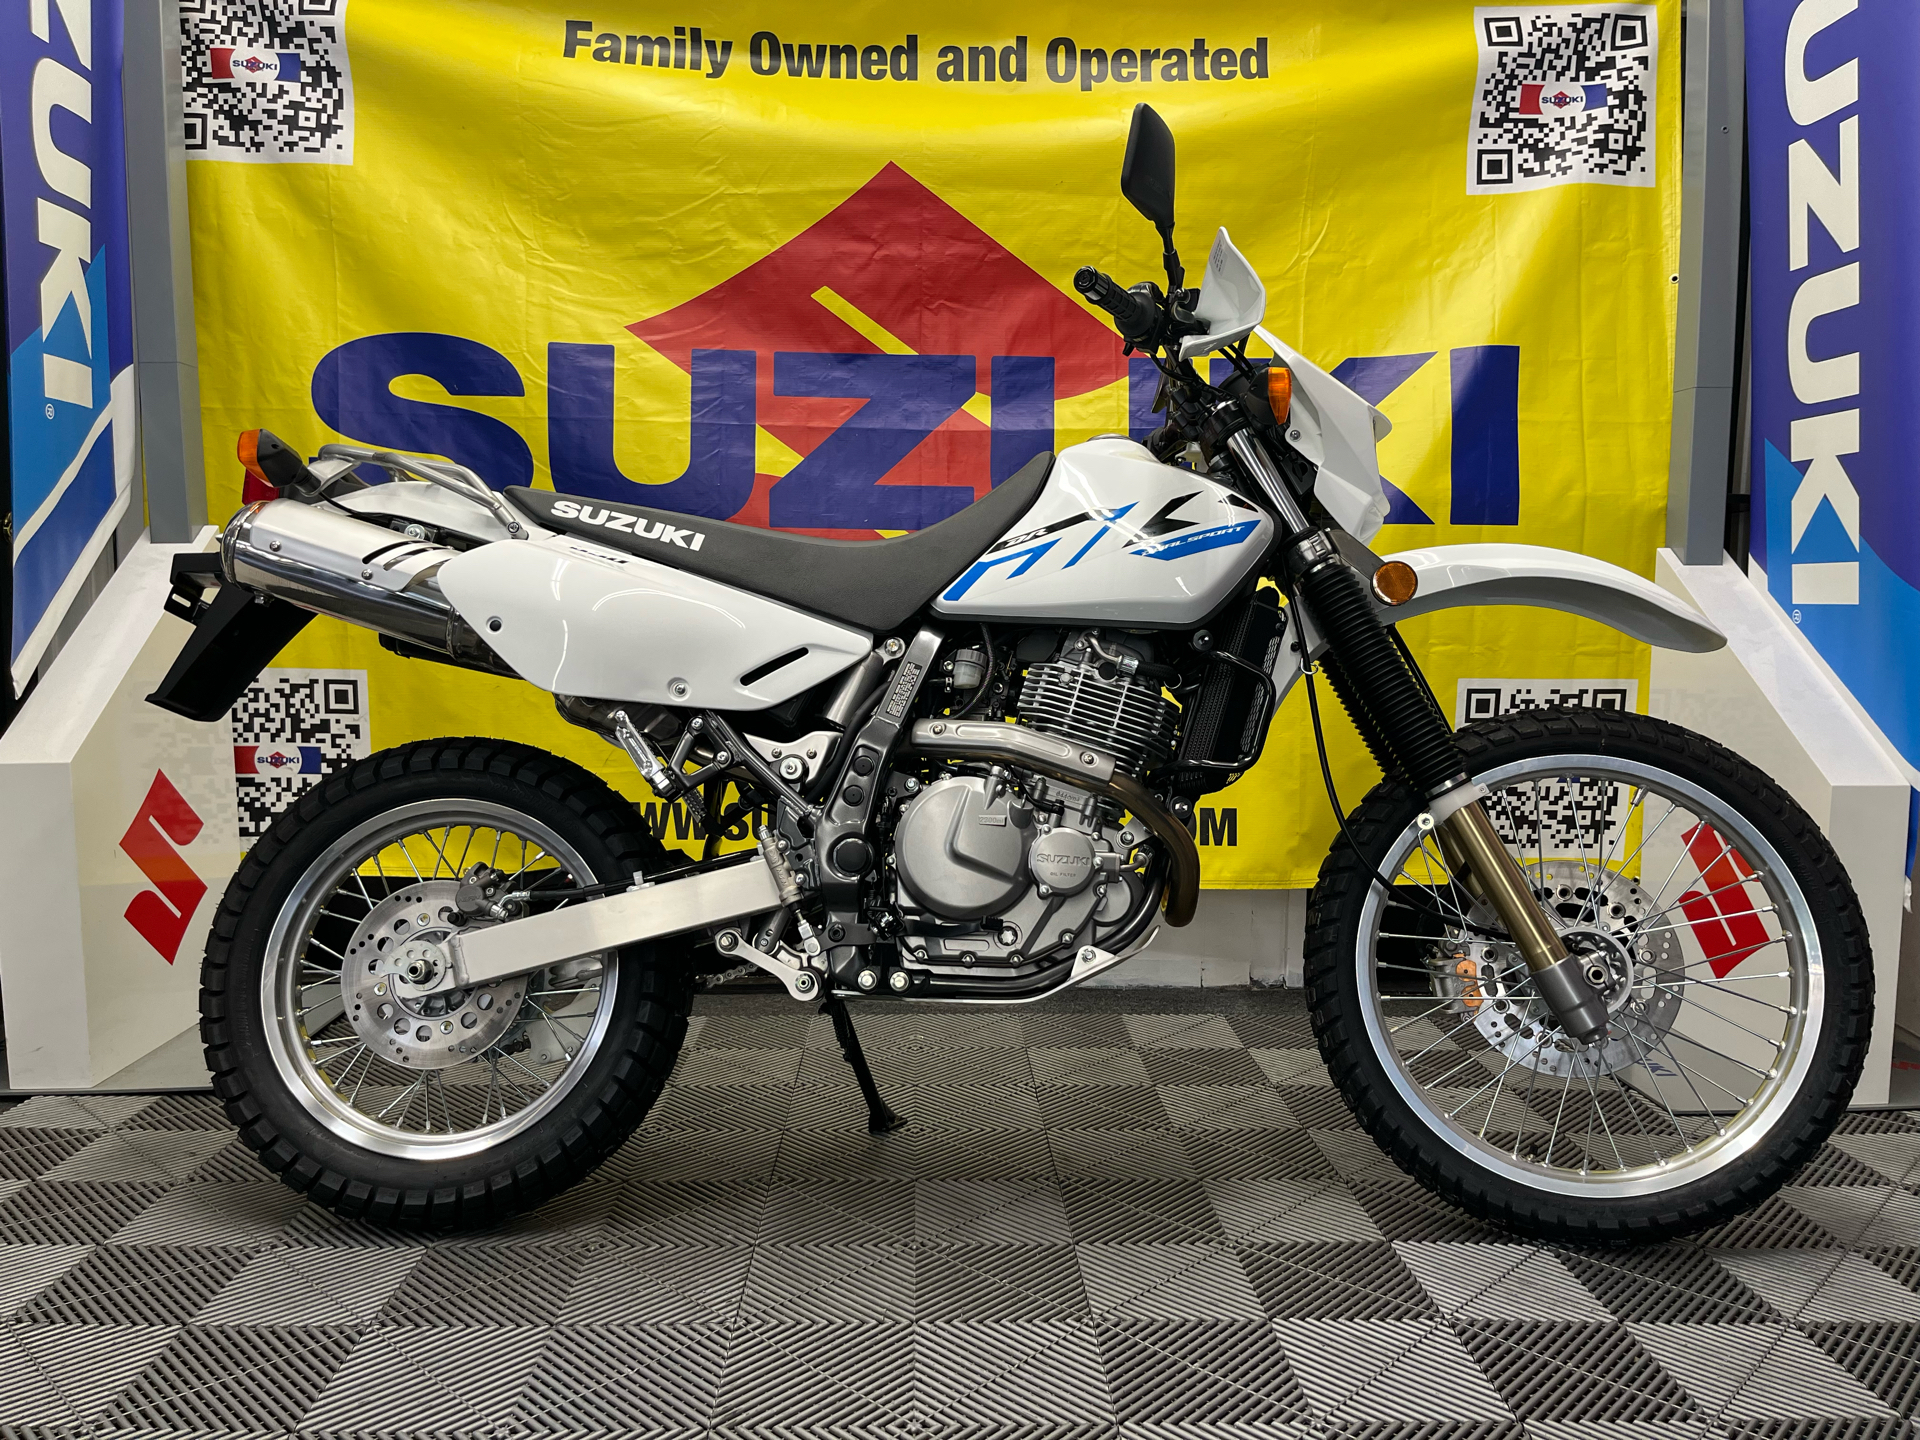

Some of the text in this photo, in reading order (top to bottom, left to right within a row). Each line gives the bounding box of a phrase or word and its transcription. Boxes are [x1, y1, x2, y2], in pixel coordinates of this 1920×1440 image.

[563, 19, 1269, 92] Family Owned and Operated
[232, 59, 278, 71] SUZUKI
[1541, 95, 1584, 104] SUZUKI
[550, 500, 706, 552] SUZUKI
[256, 756, 300, 764] SUZUKI
[1036, 852, 1090, 866] SUZUKI
